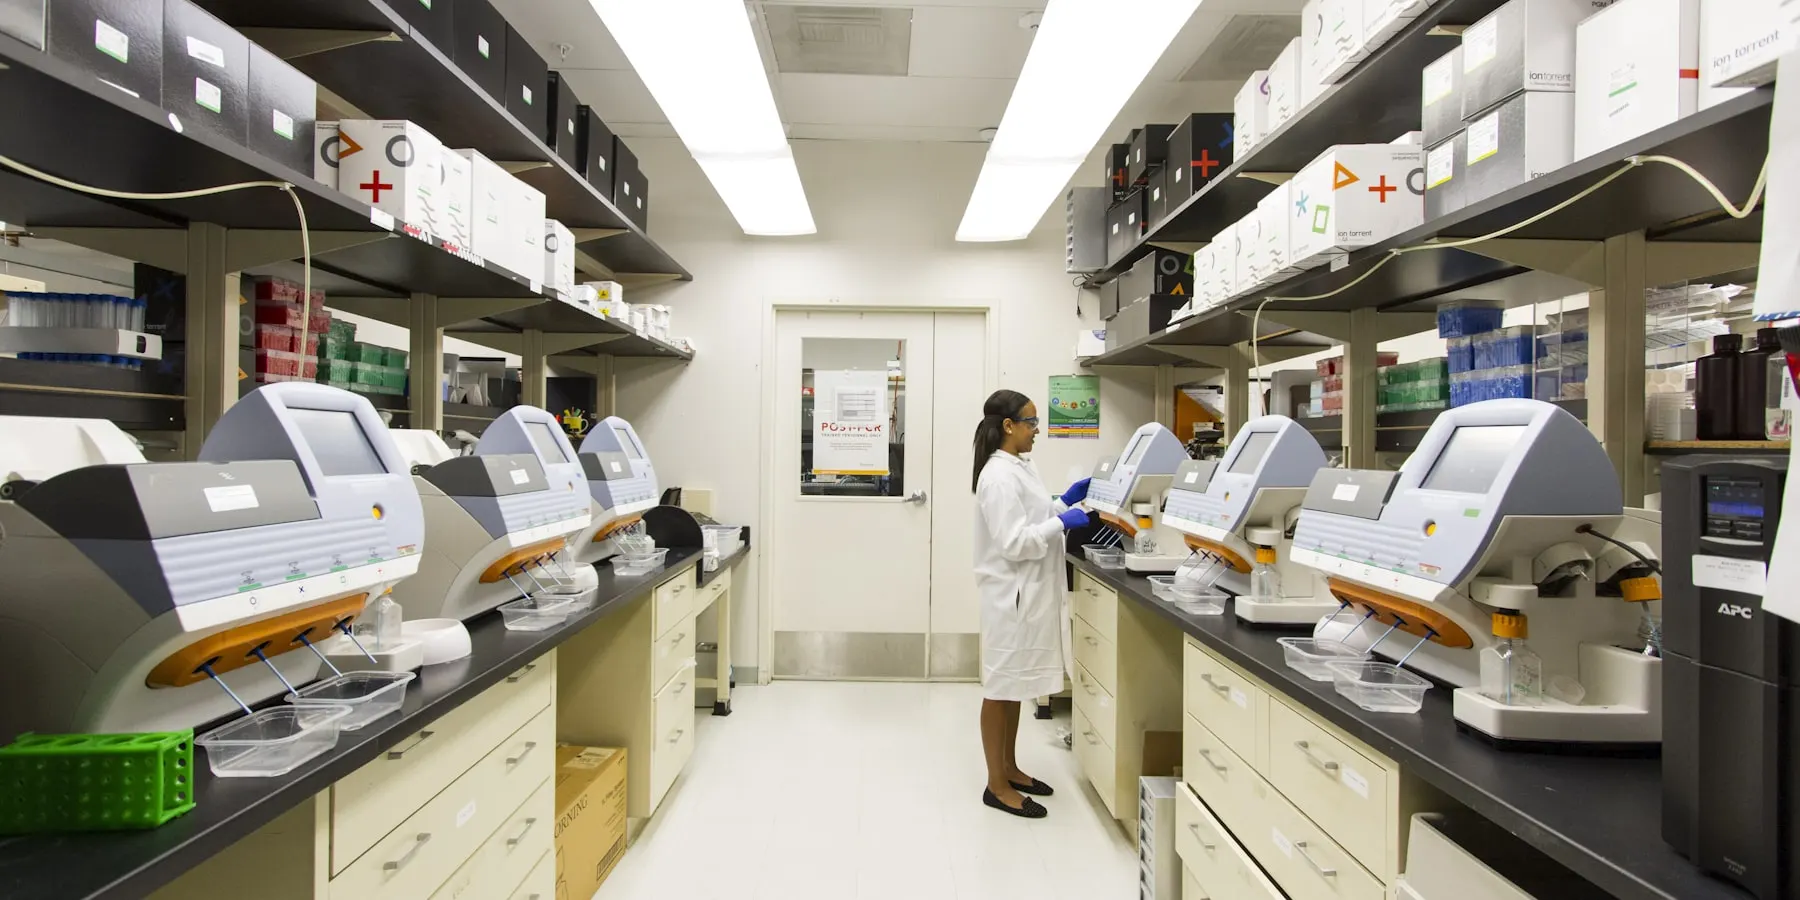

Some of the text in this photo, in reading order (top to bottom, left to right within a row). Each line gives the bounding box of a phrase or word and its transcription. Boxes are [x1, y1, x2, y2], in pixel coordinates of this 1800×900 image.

[1713, 29, 1780, 69] ion torrent
[1349, 229, 1372, 237] torrent
[1717, 602, 1752, 619] APC
